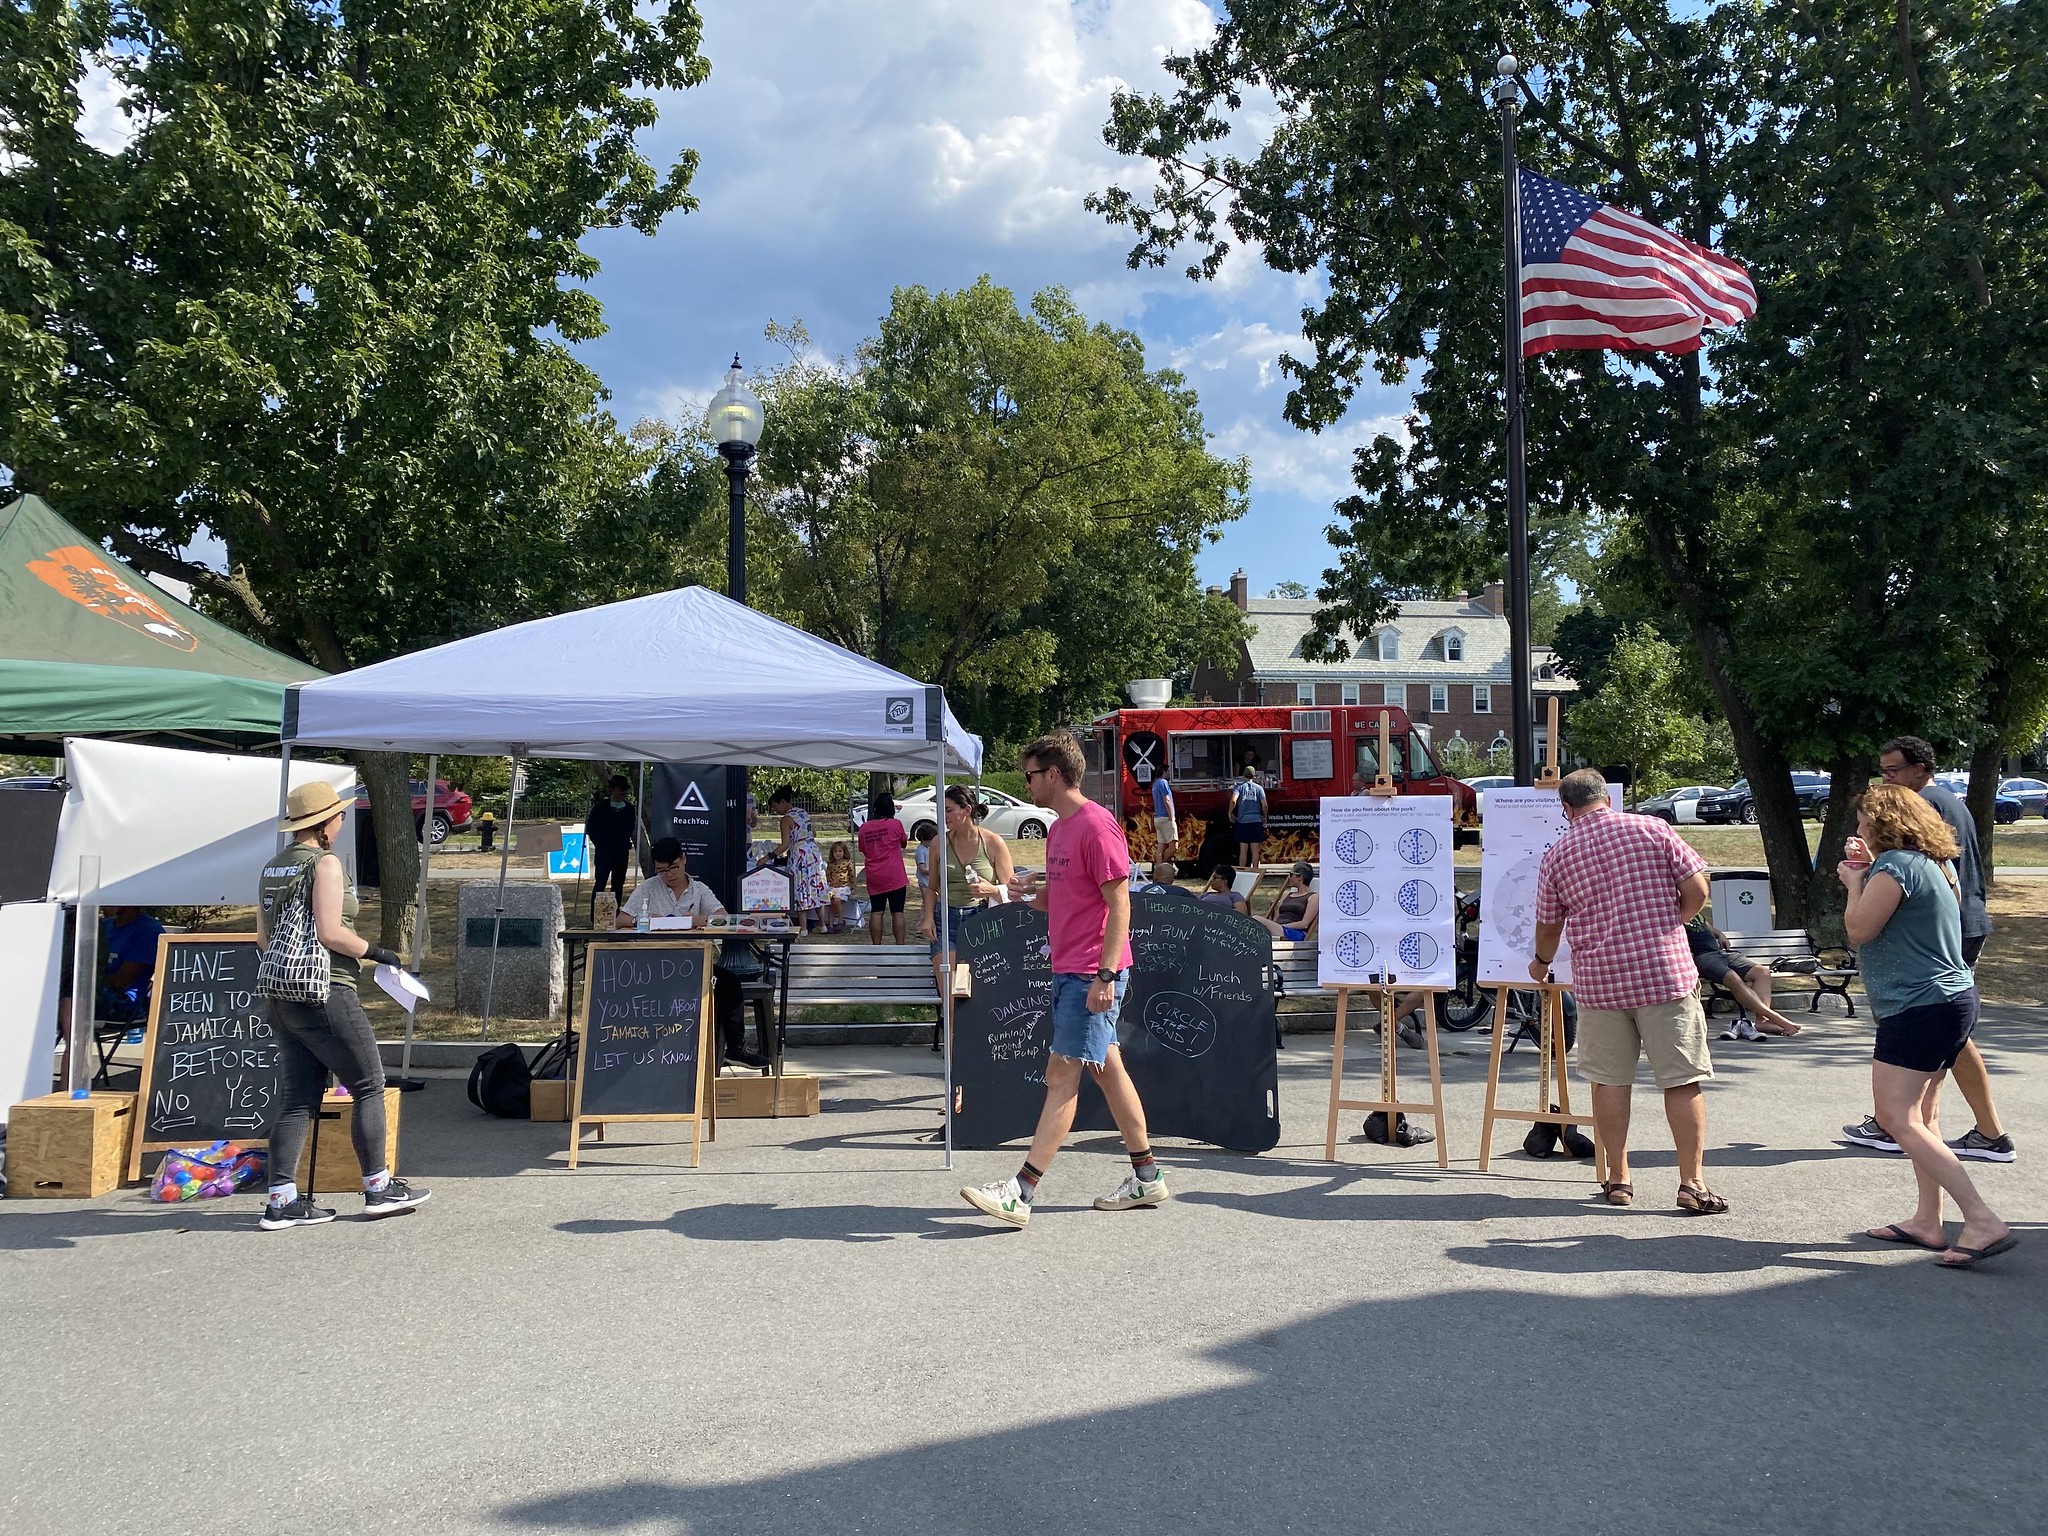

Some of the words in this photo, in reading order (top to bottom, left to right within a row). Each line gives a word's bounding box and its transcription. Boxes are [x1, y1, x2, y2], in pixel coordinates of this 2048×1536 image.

[673, 817, 709, 825] ReachYou
[964, 918, 1006, 948] WHAT
[1015, 909, 1034, 928] IS
[1160, 924, 1196, 941] RUN!
[1207, 911, 1221, 921] AT
[1224, 914, 1240, 929] THE
[171, 949, 236, 983] HAVE
[601, 957, 651, 993] HOW
[660, 960, 694, 980] DO
[1198, 964, 1242, 985] Lunch
[169, 990, 213, 1013] BEEN
[224, 990, 252, 1010] TO
[1192, 984, 1253, 1003] w/Friends
[597, 998, 630, 1029] YOU
[632, 995, 665, 1018] FEEL
[988, 994, 1051, 1022] DANCING
[1155, 1002, 1209, 1033] CIRCLE
[163, 1016, 245, 1045] JAMAICA
[600, 1024, 649, 1043] JAMAICA
[652, 1018, 695, 1040] POND?
[1162, 1018, 1190, 1031] THE
[594, 1050, 629, 1071] LET
[632, 1048, 656, 1065] US
[660, 1045, 698, 1065] KNOW!
[155, 1088, 190, 1118] NO
